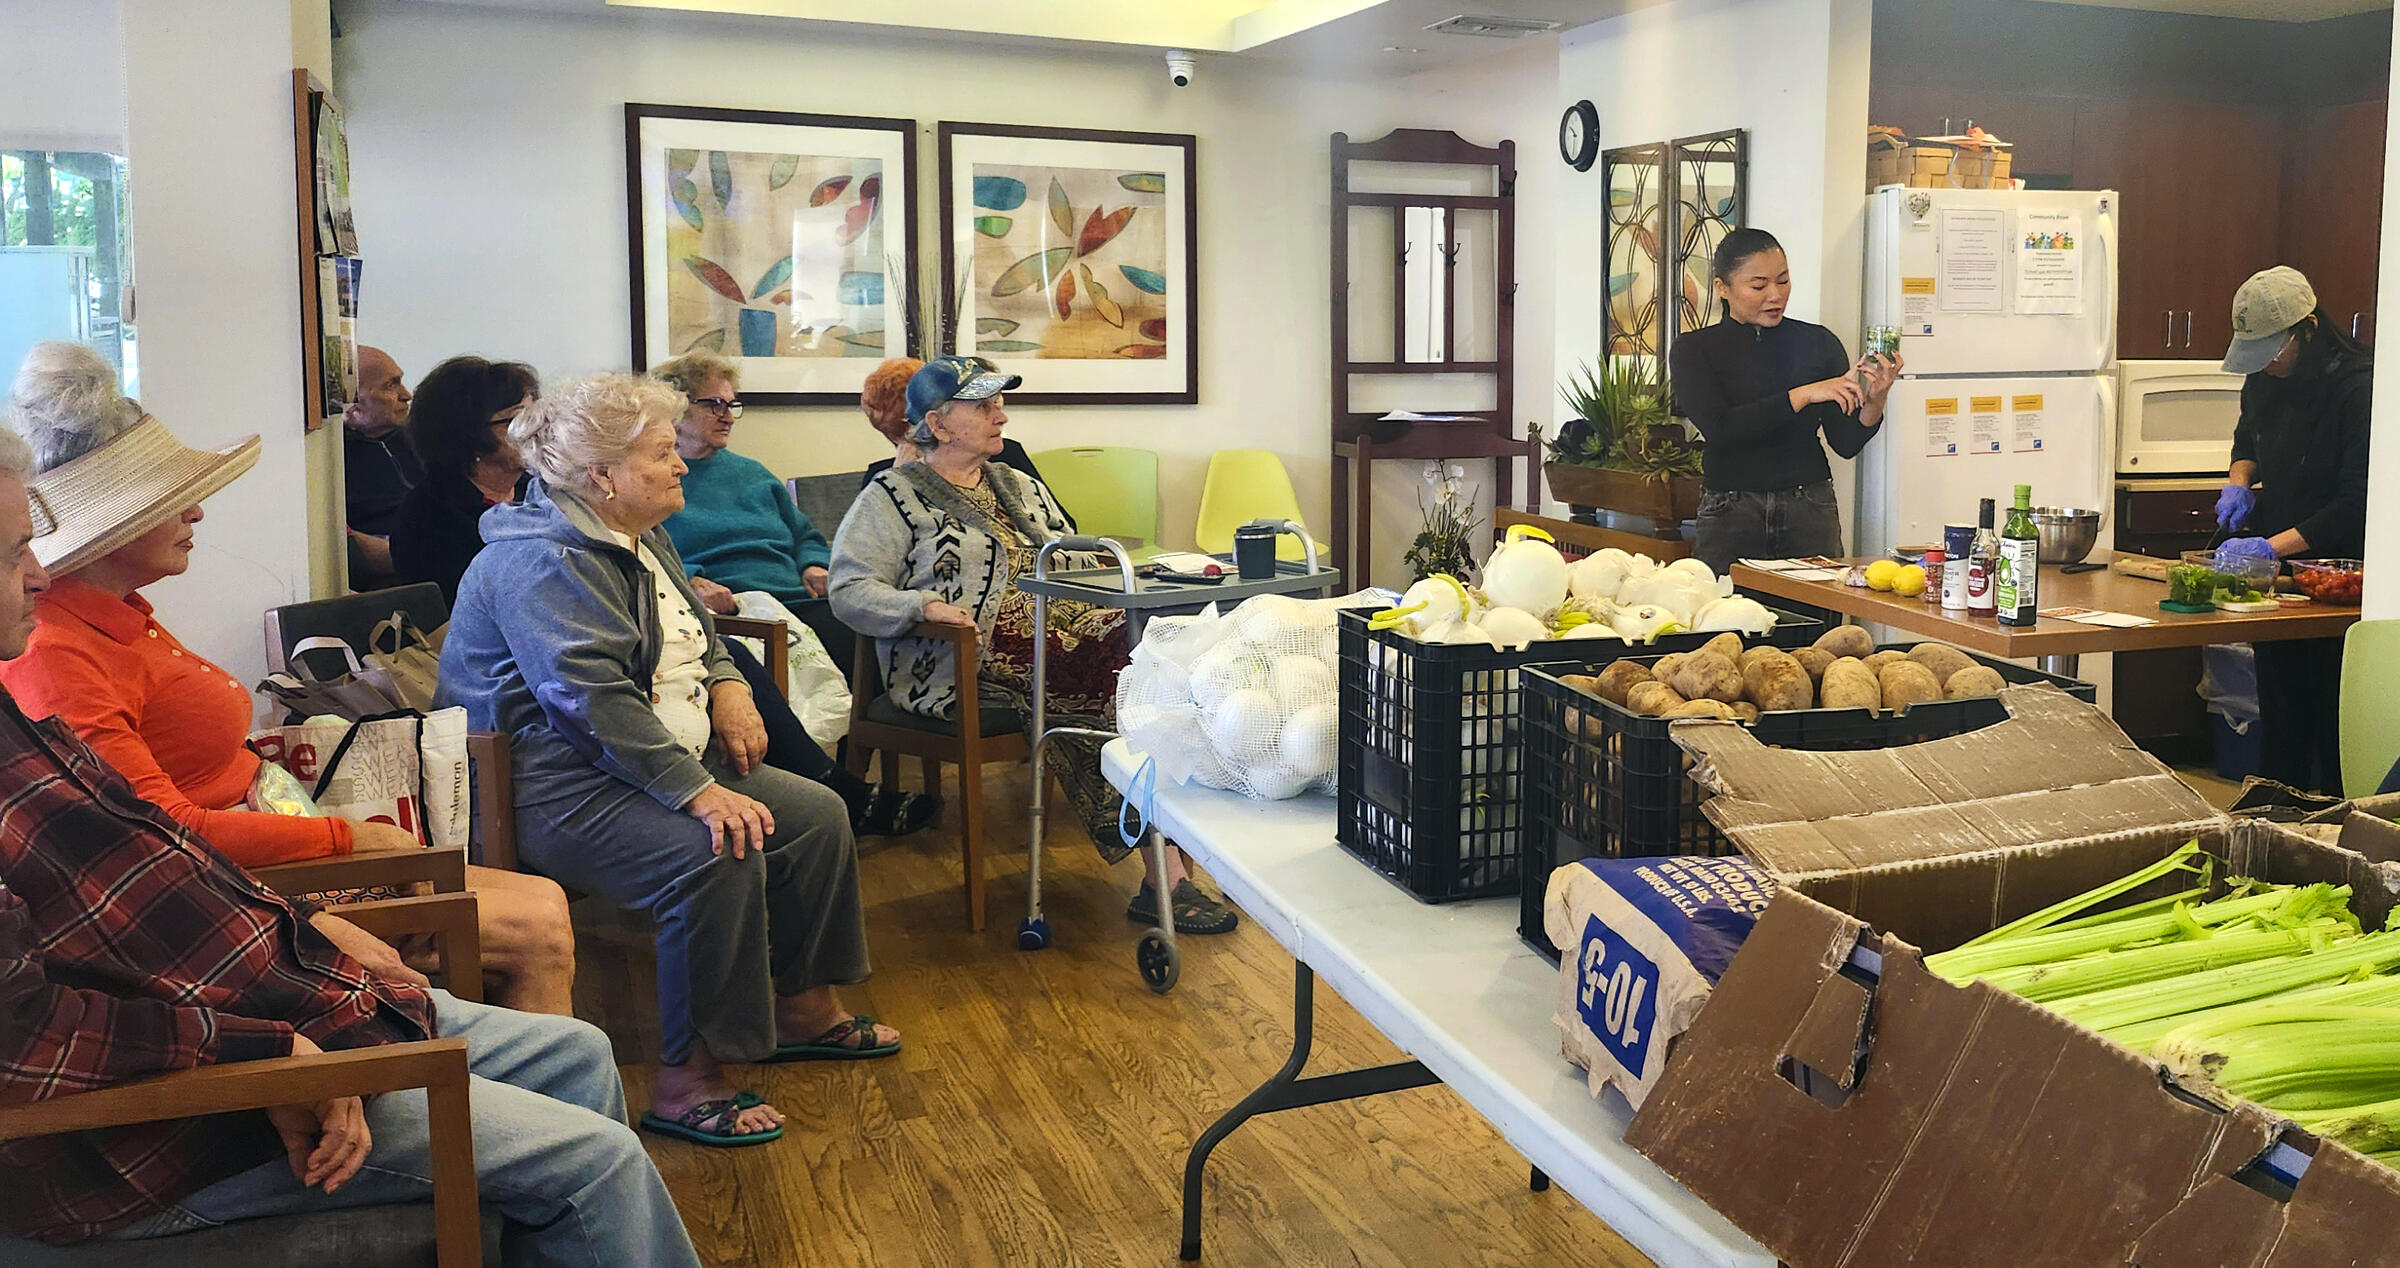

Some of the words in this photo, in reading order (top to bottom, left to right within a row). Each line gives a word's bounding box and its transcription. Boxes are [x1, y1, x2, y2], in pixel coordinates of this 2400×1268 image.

[1632, 865, 1671, 893] PRODUCE
[1671, 894, 1698, 919] U.S.A.
[1709, 863, 1769, 920] PRODUC
[1582, 937, 1648, 1049] 10-5
